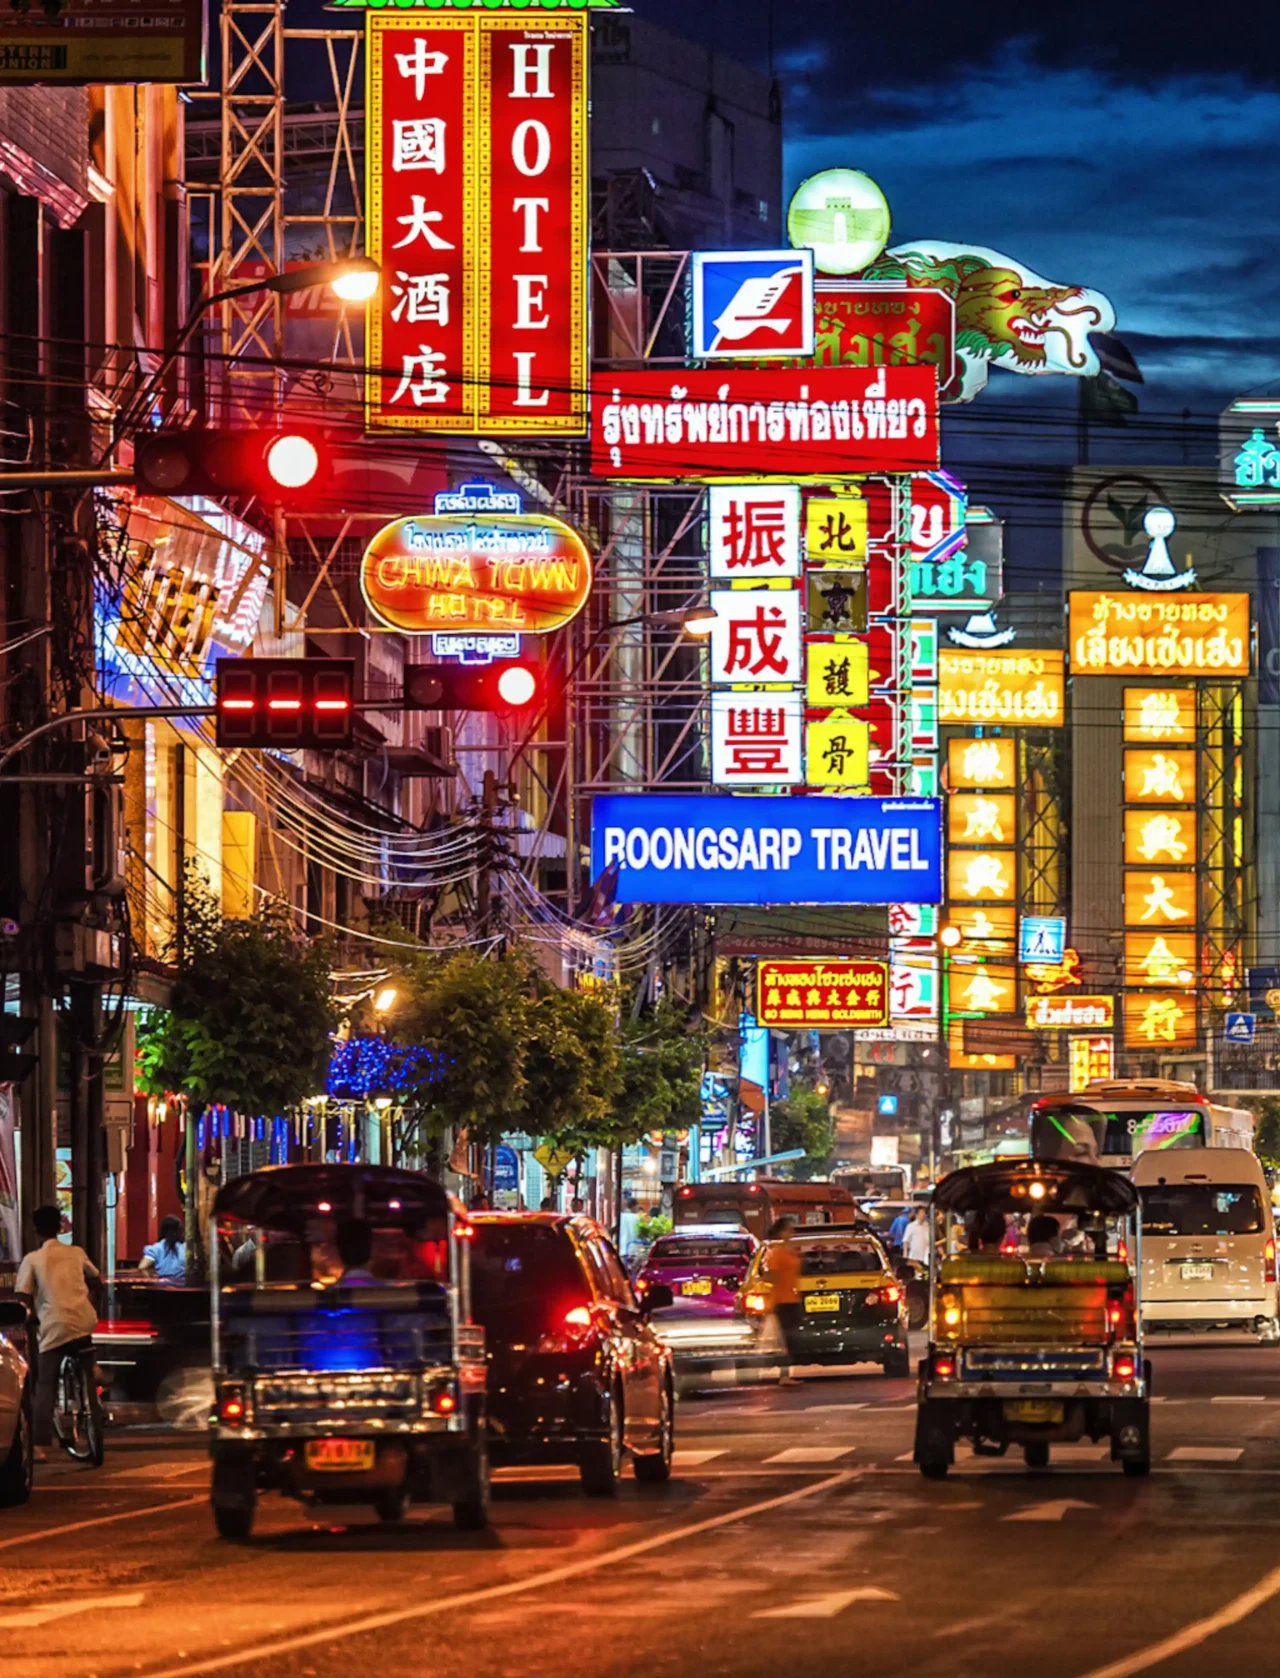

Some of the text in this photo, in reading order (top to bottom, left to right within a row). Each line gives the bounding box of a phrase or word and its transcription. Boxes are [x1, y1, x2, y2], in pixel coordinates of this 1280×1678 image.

[391, 38, 455, 408] 中國大酒店
[507, 44, 555, 407] HOTEL
[377, 555, 580, 592] CHINA TOWN
[1092, 596, 1228, 622] ห้างขายทอง
[604, 827, 929, 871] ROONGSARP TRAVEL
